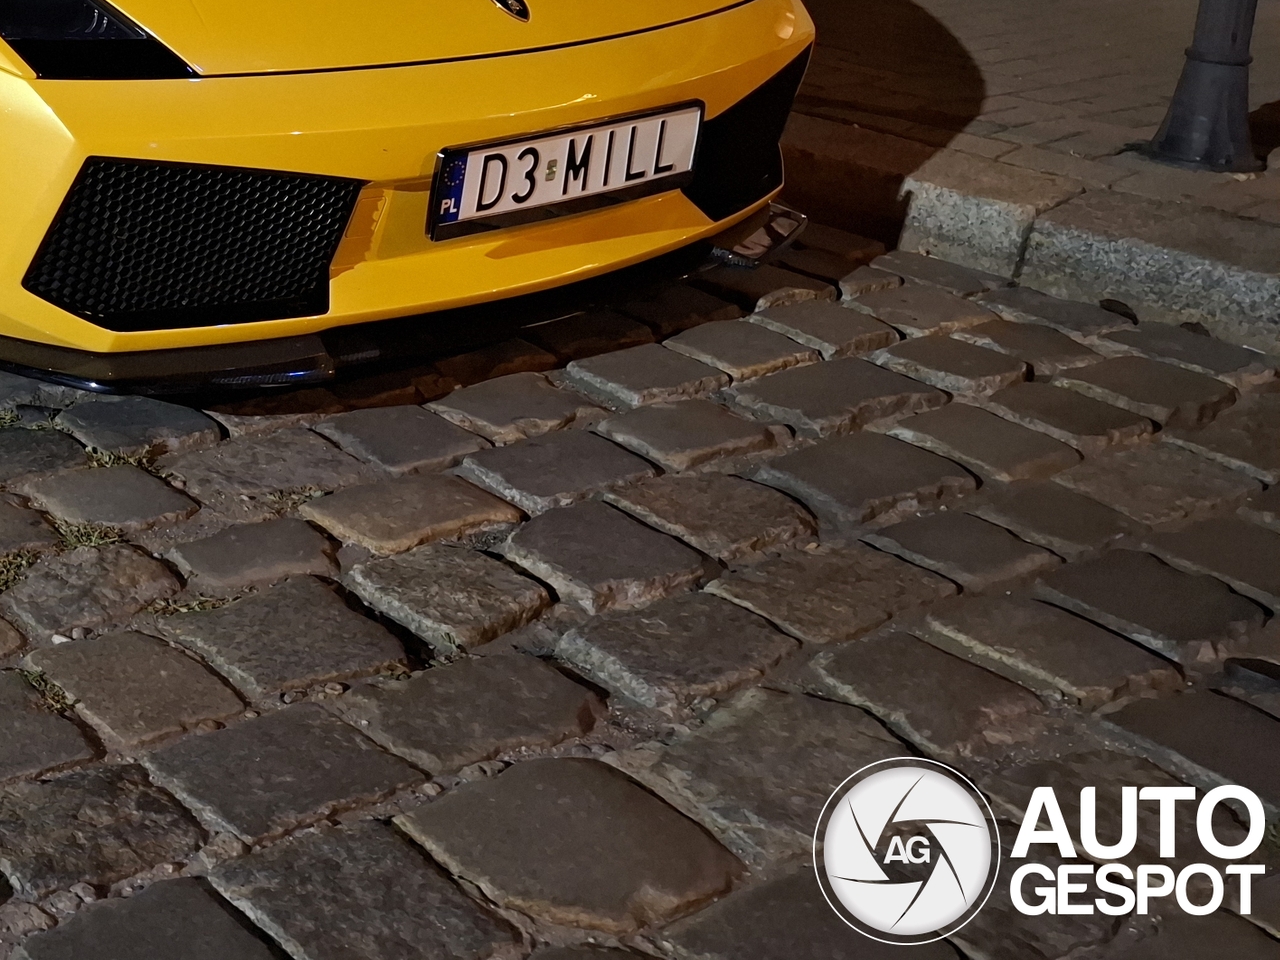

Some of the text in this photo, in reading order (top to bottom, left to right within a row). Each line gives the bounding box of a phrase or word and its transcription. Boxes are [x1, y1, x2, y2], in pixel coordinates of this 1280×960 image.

[475, 119, 674, 212] D3 MILL
[439, 198, 458, 216] PL
